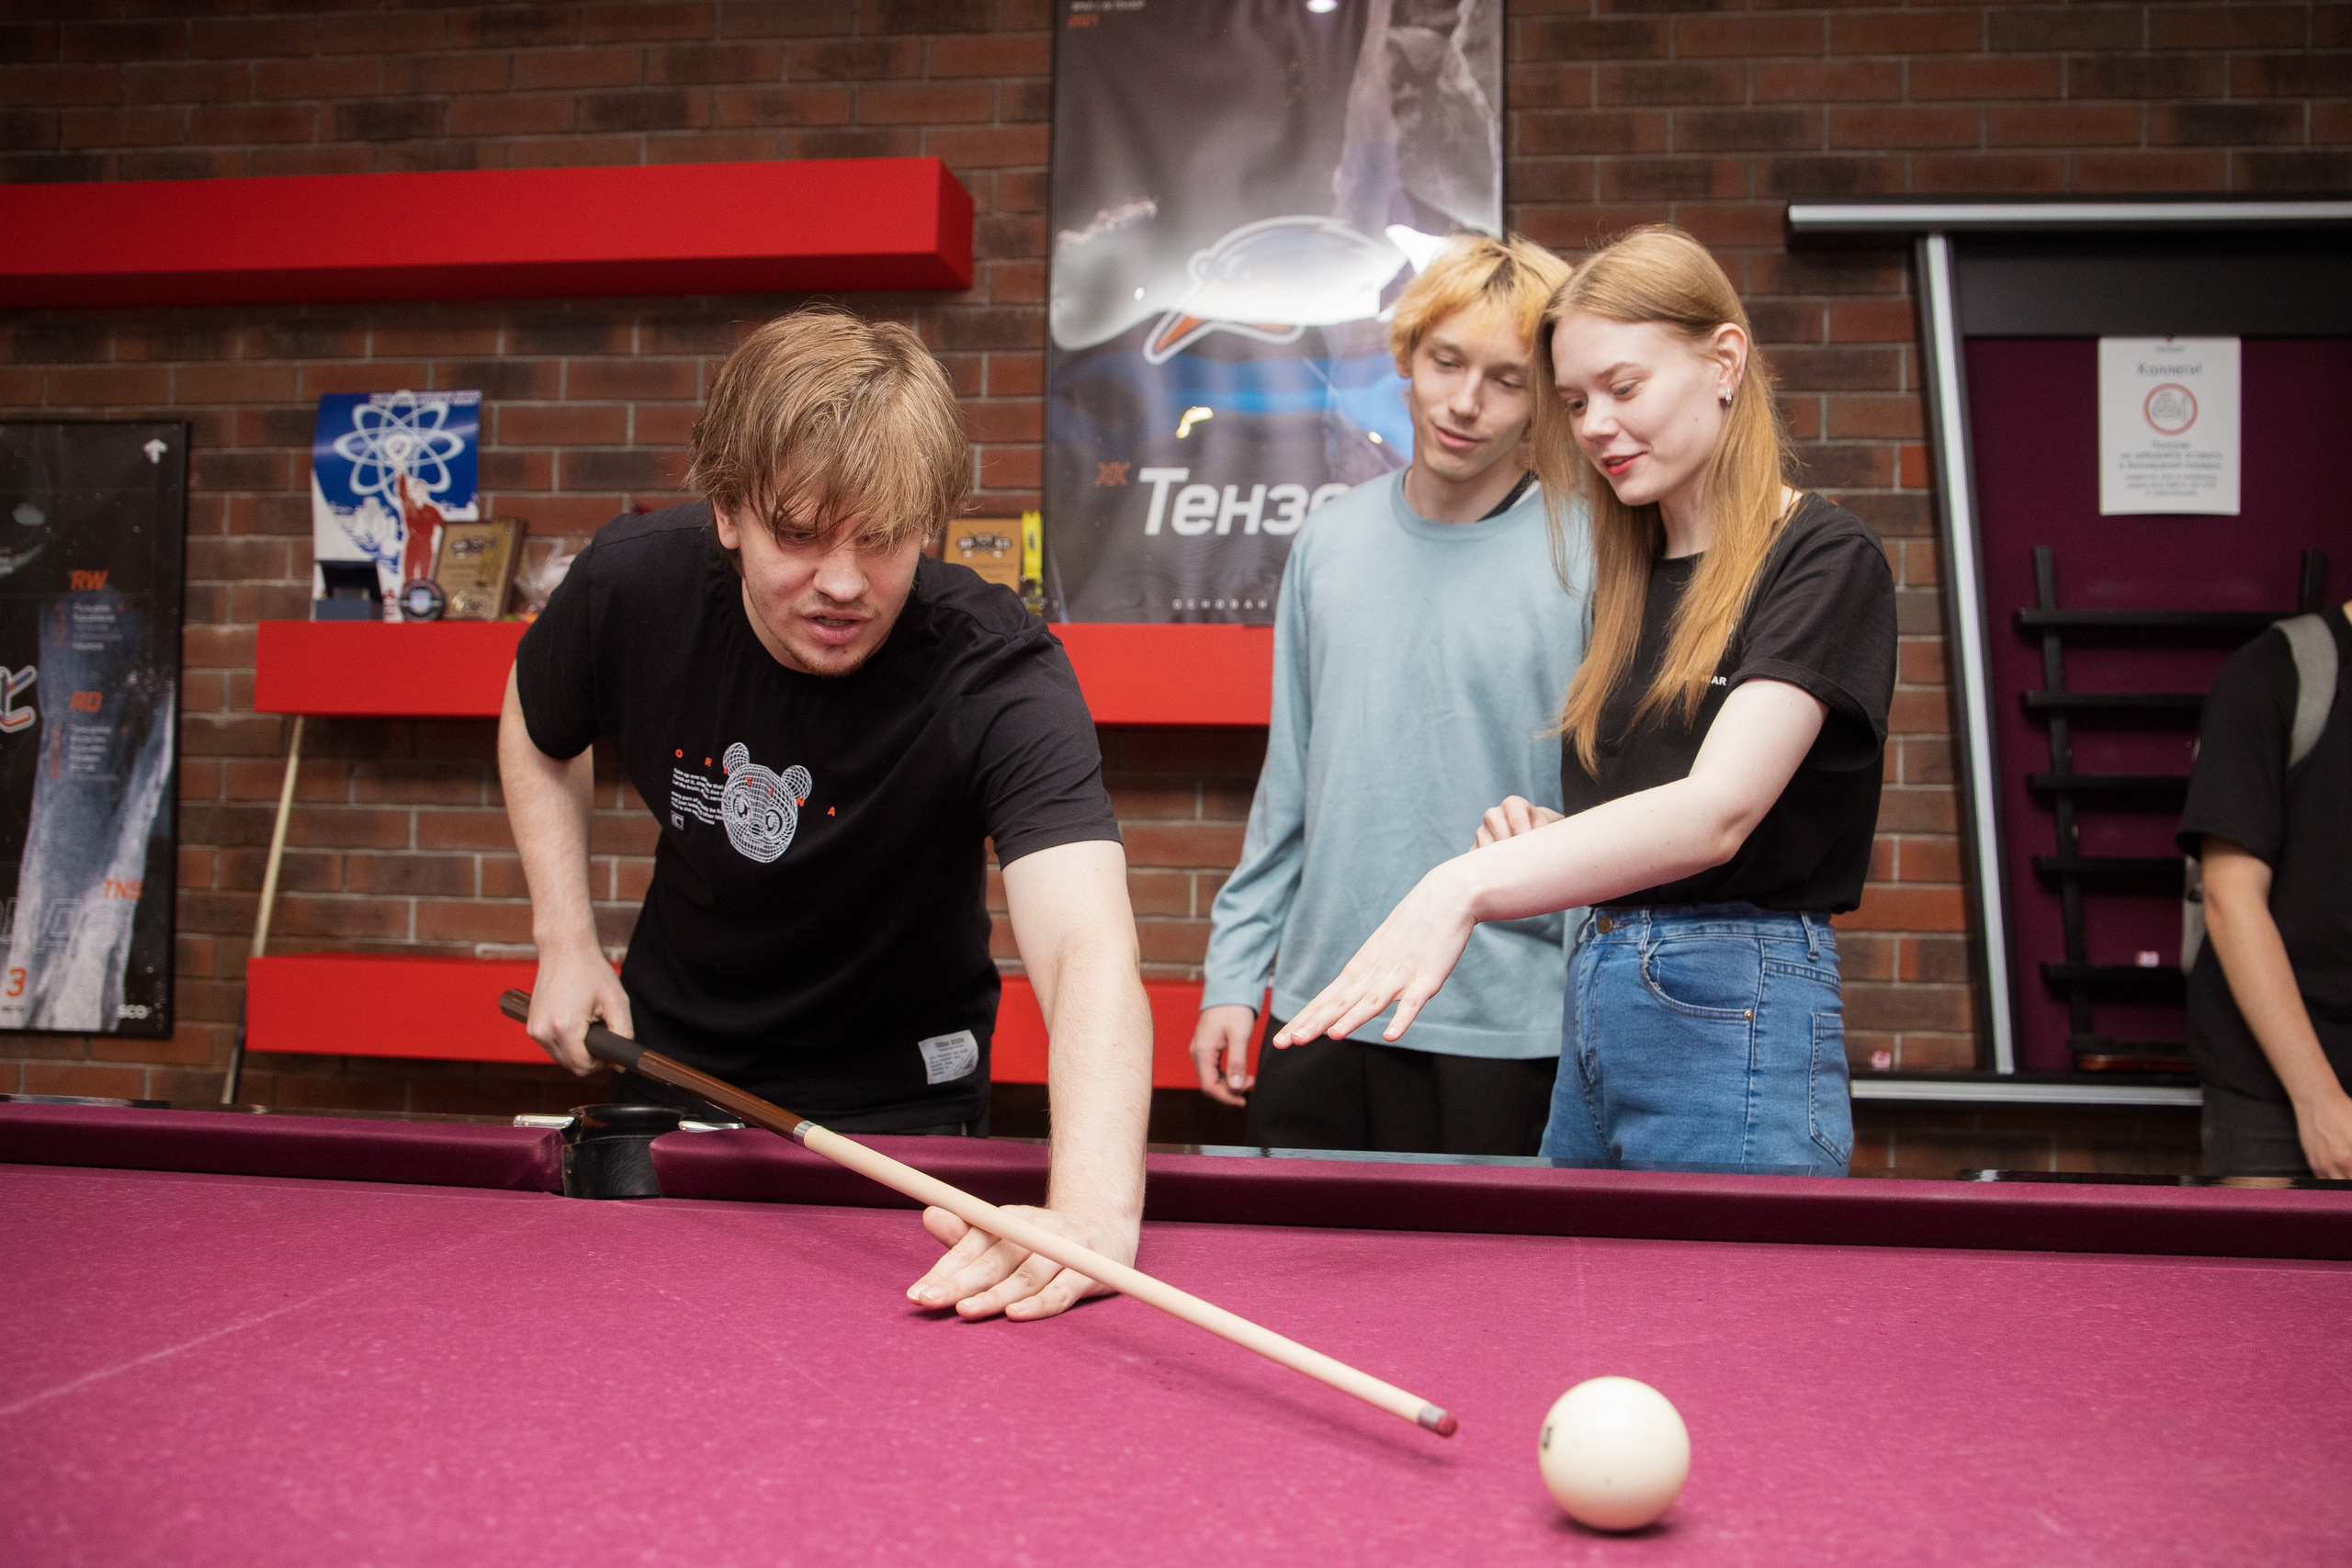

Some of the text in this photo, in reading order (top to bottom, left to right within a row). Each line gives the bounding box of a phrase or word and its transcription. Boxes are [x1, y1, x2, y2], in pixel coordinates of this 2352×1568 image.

[71, 570, 108, 591] RW
[1711, 675, 1726, 686] AR
[103, 879, 143, 900] TNS
